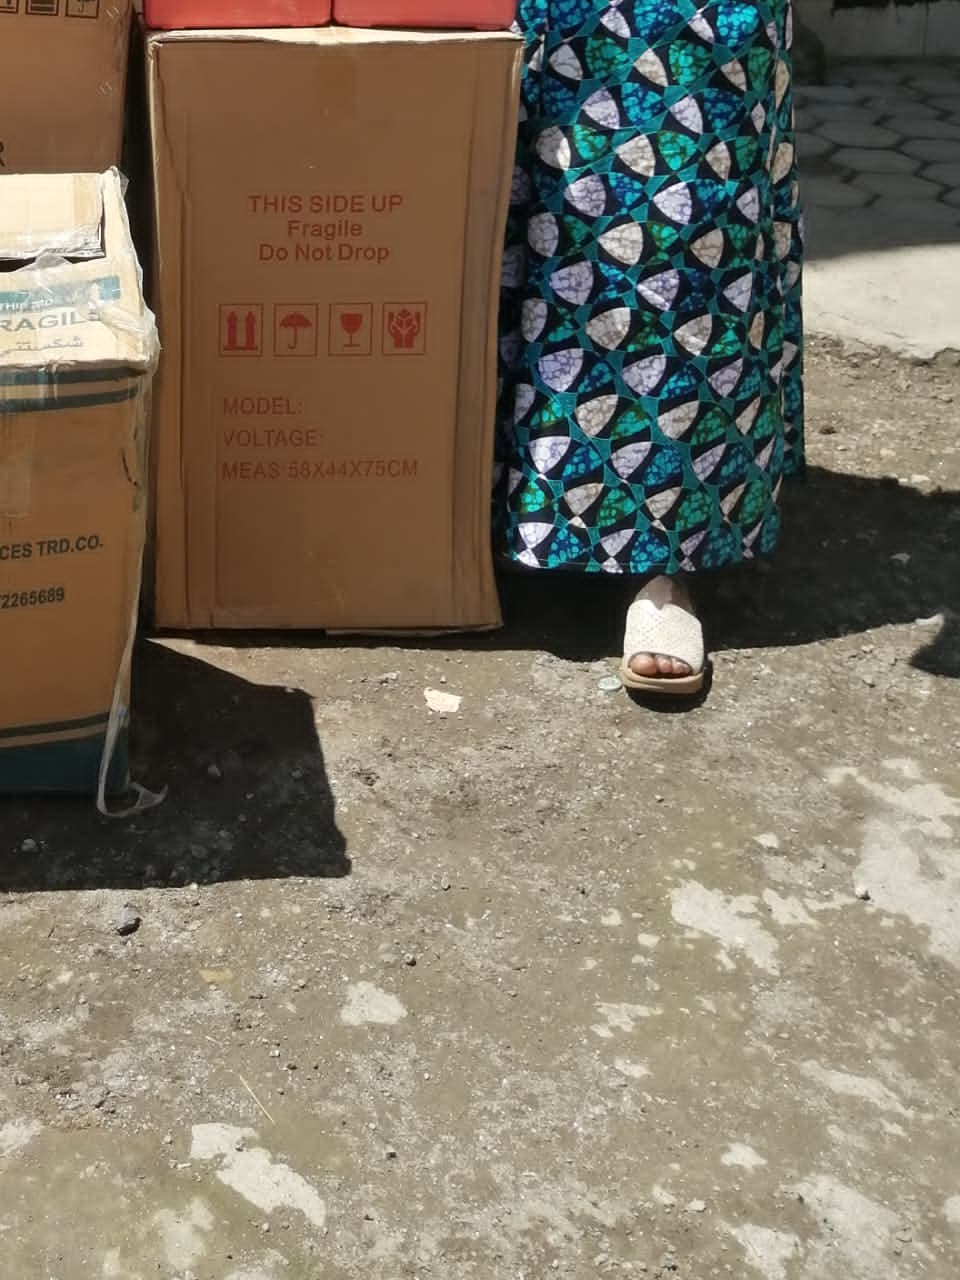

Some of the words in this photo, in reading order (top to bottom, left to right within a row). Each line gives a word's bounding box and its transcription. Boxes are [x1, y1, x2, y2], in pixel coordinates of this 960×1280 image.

[248, 195, 303, 214] THIS
[309, 195, 366, 214] SIDE
[371, 194, 403, 213] UP
[287, 219, 363, 241] Fragile
[259, 243, 289, 261] Do
[295, 243, 332, 261] Not
[337, 243, 390, 264] Drop
[222, 396, 304, 417] MODEL:
[287, 458, 419, 481] 58X44X75CM
